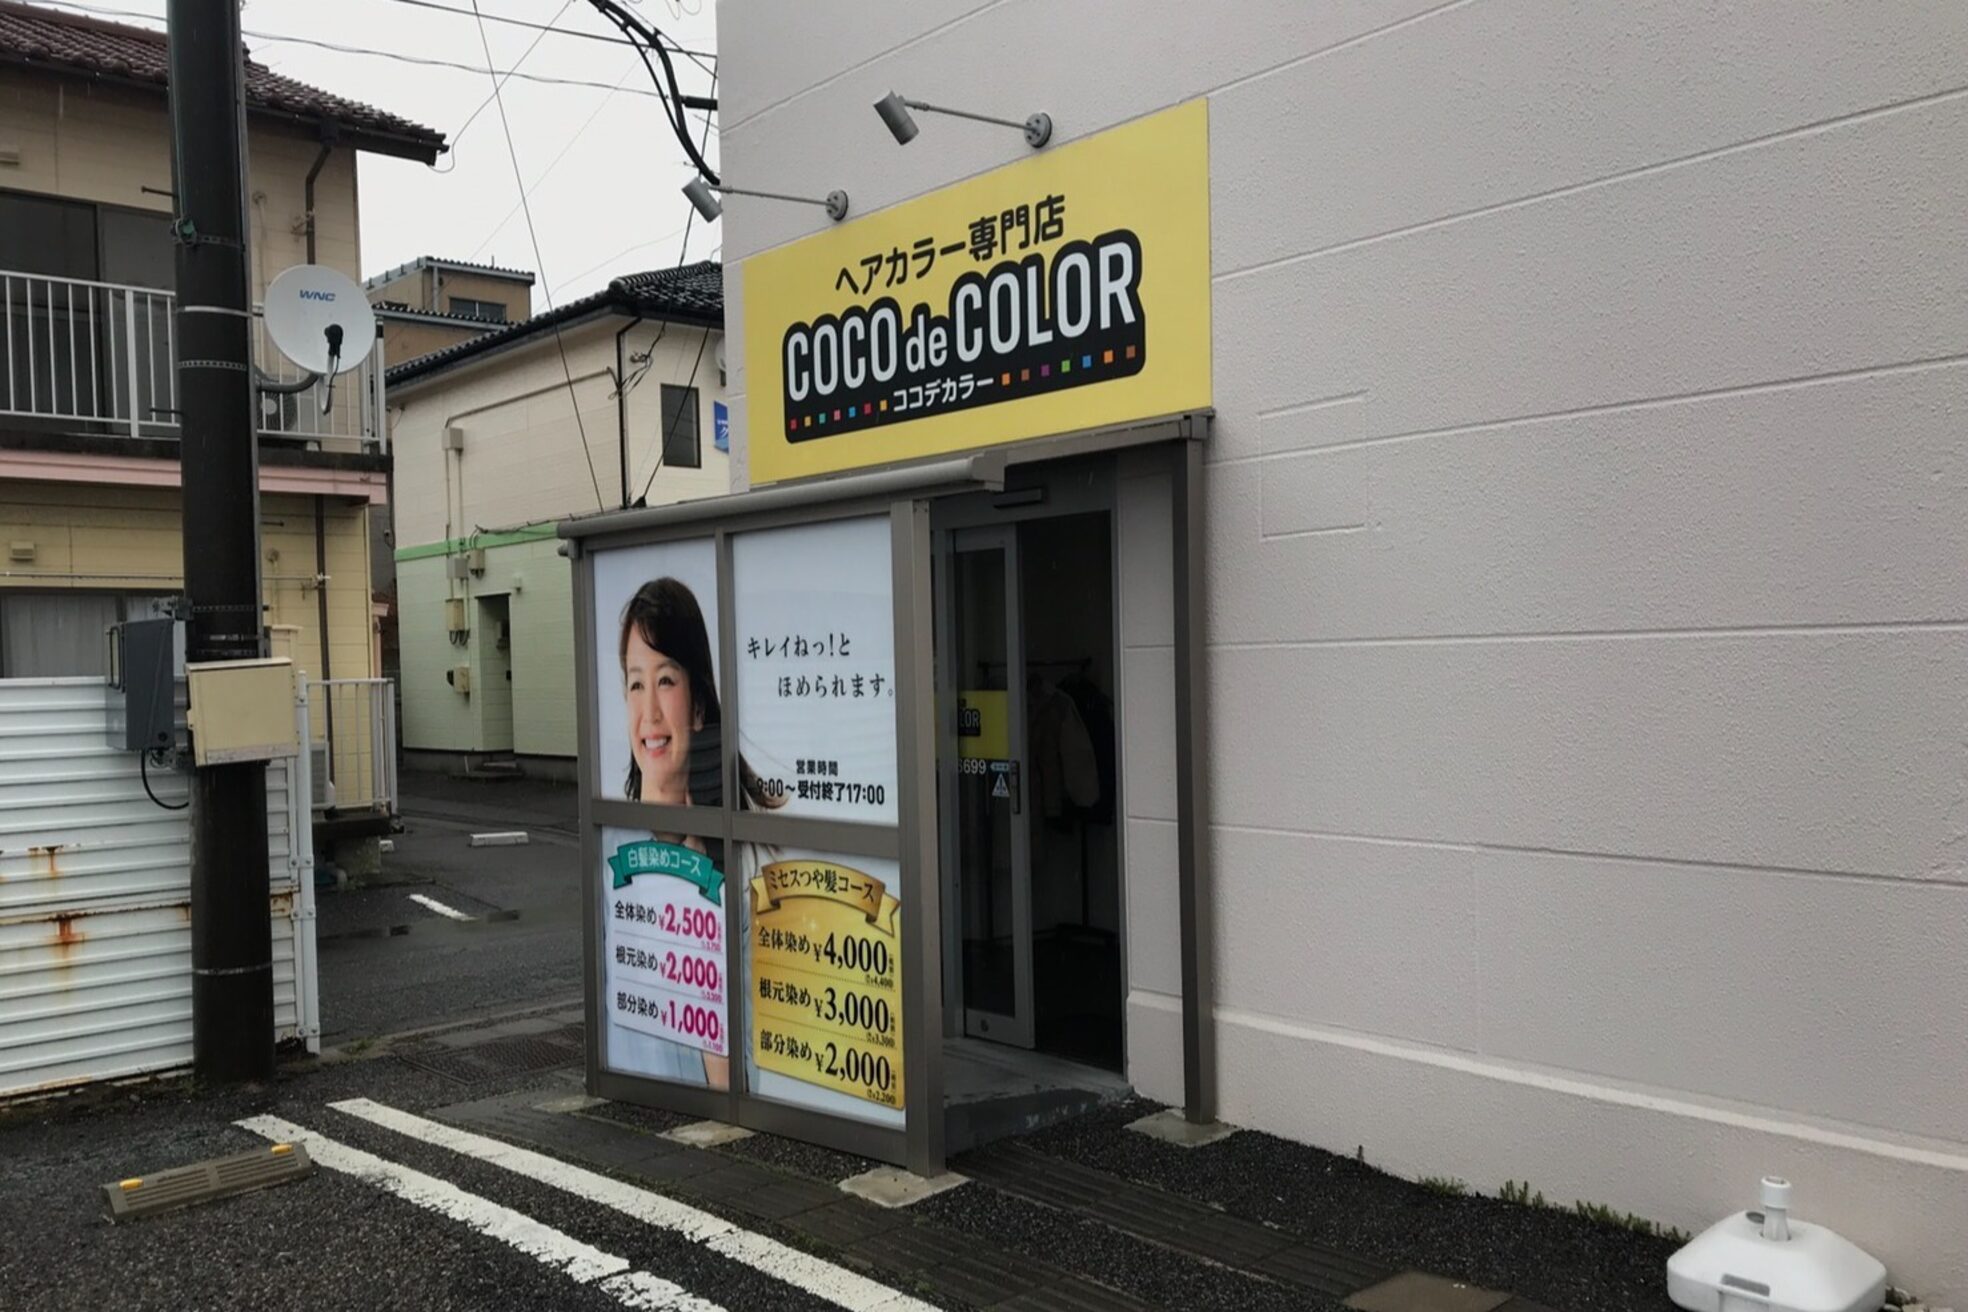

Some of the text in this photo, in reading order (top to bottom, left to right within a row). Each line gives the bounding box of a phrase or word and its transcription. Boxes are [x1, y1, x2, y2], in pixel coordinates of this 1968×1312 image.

[834, 194, 1065, 295] ヘアカラー専門店
[299, 290, 336, 302] WNC
[893, 374, 994, 412] ココデカラー
[778, 673, 893, 698] ほめられます。
[796, 760, 838, 776] 営業時間
[628, 849, 701, 877] 白髪染めコース
[768, 868, 874, 902] ミセスつや髪コース
[614, 901, 657, 924] 全体染め
[758, 926, 810, 954] 全体染め
[616, 945, 658, 971] 根元染め
[617, 992, 659, 1019] 部分染め
[759, 977, 811, 1008] 根元染め
[760, 1029, 812, 1061] 部分染め
